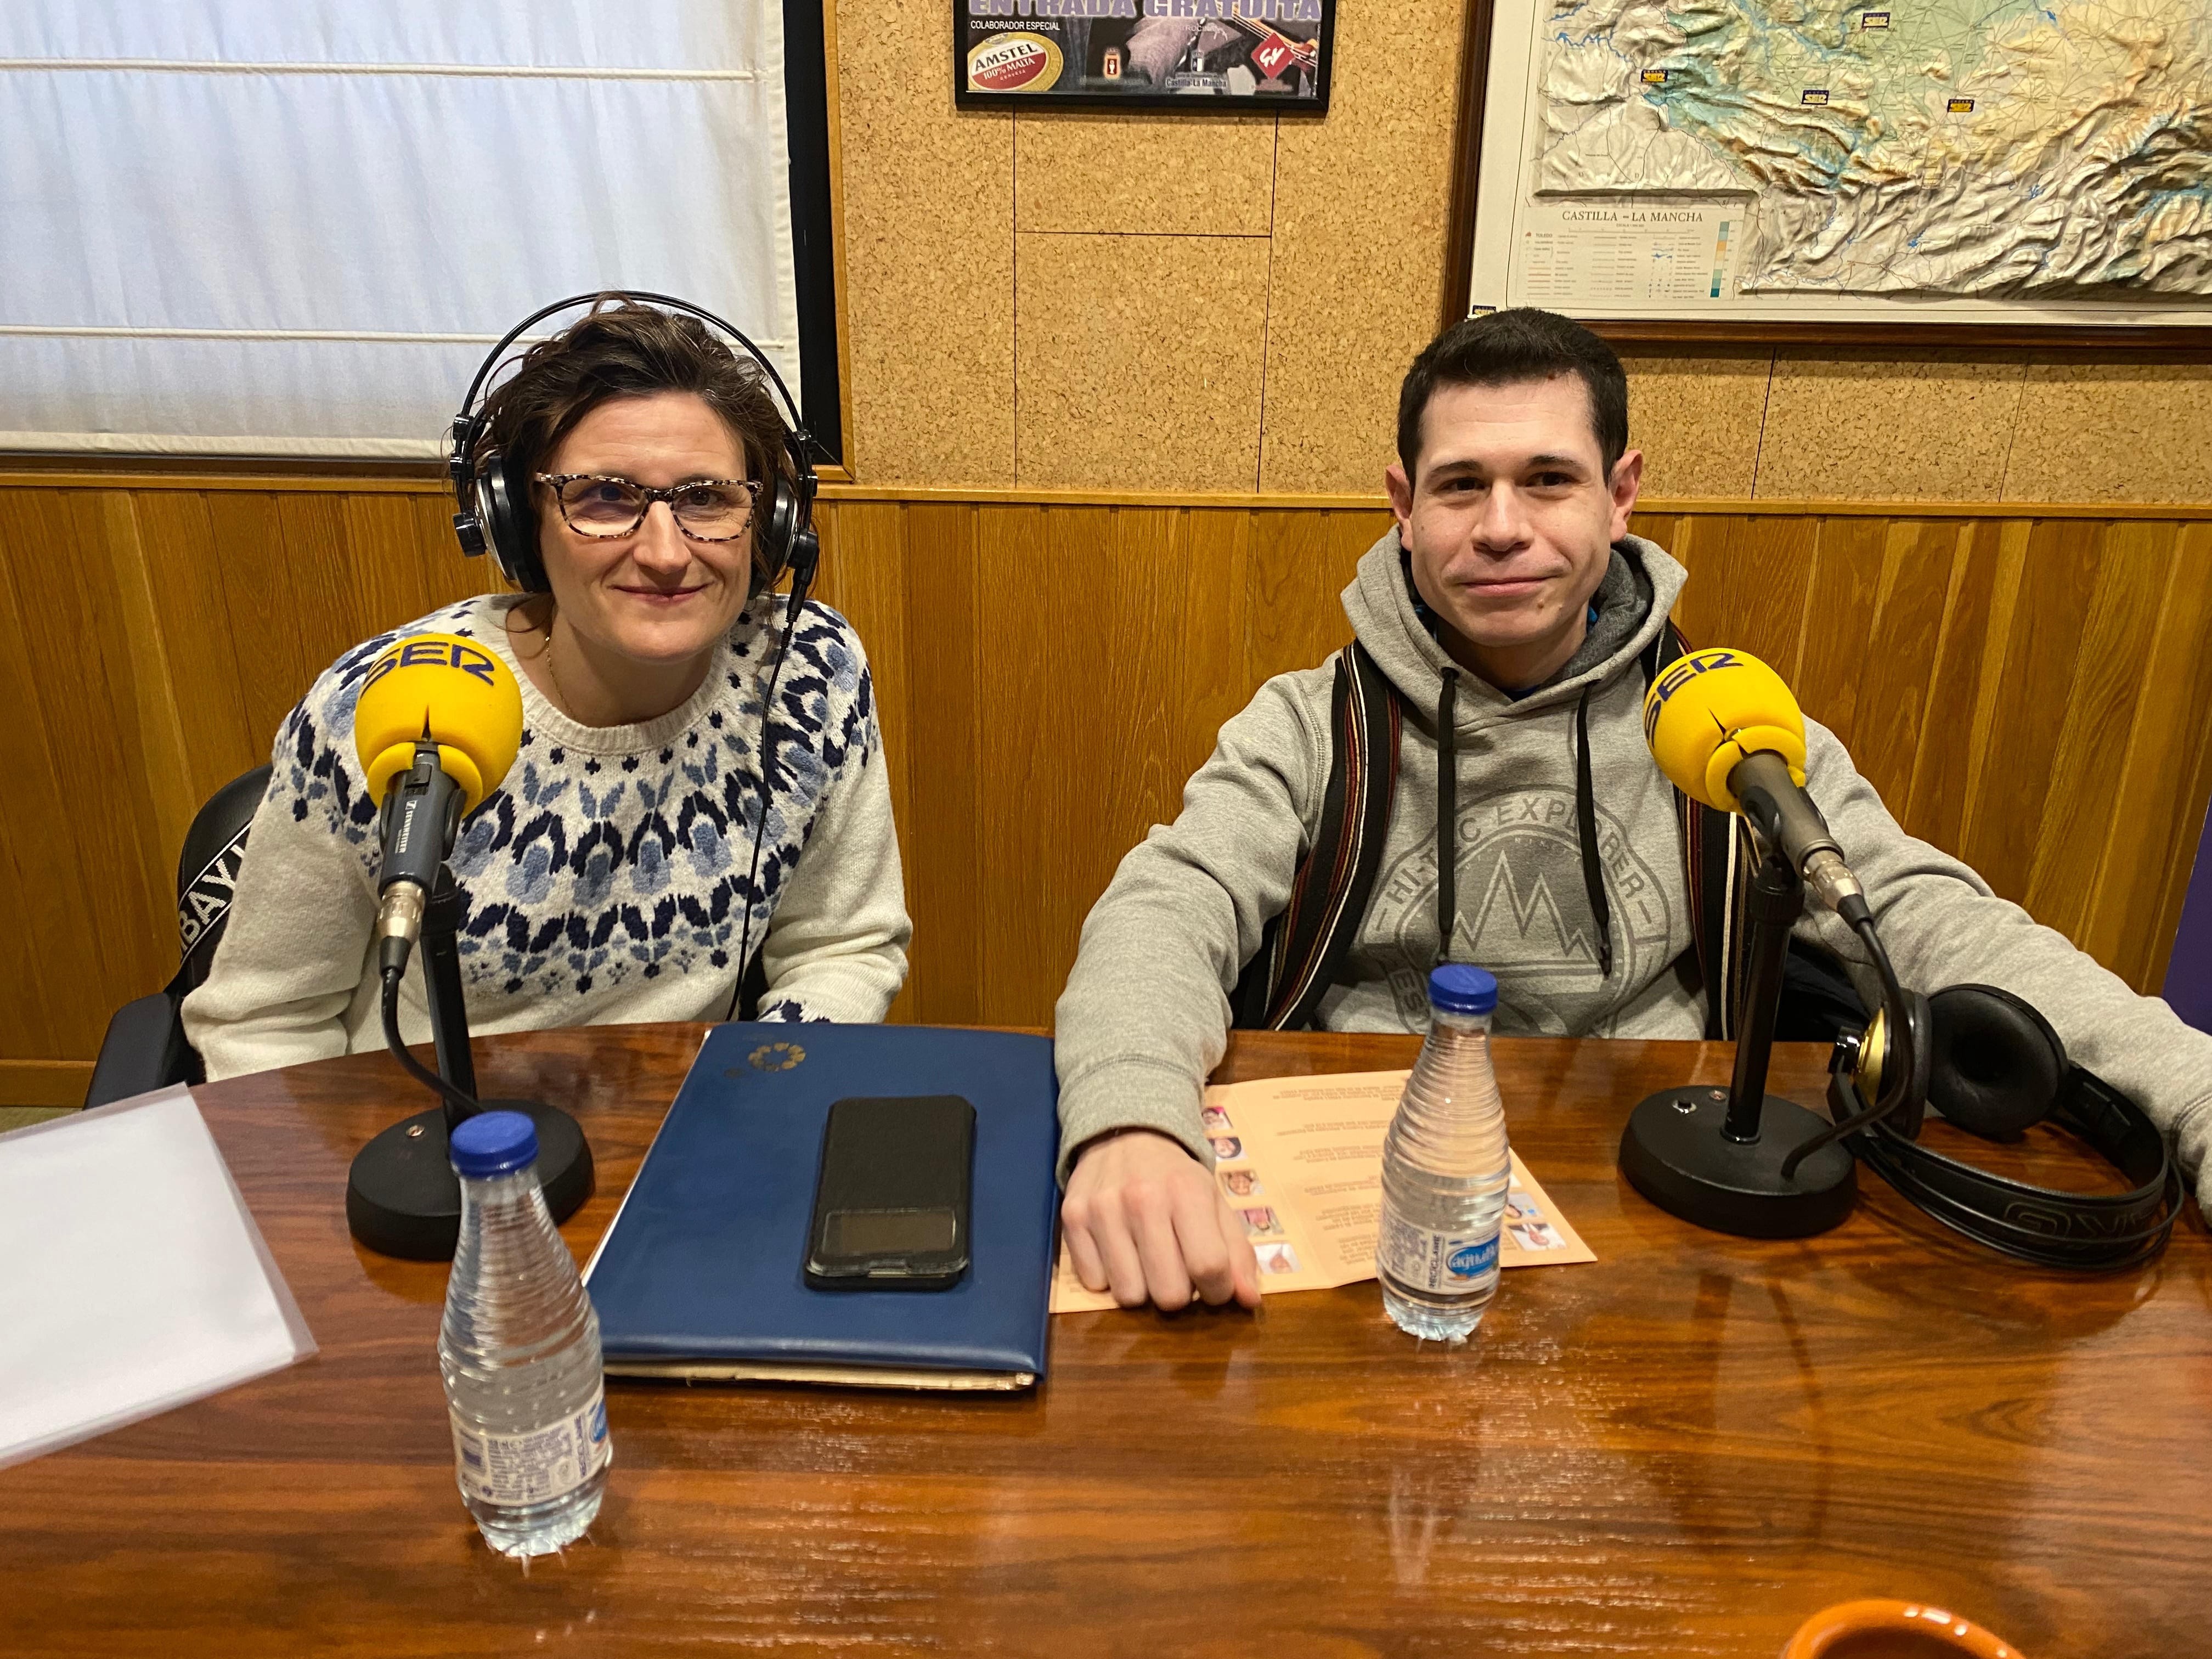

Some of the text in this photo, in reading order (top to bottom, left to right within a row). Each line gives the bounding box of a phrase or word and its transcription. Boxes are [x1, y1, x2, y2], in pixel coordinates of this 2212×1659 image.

[969, 0, 1321, 20] ENTRADA GRATUITA
[970, 20, 1060, 31] COLABORADOR ESPECIAL
[975, 43, 1038, 72] AMSTEL
[983, 57, 1036, 80] 100% MALTA
[1562, 211, 1618, 221] CASTILLA
[1650, 212, 1703, 222] MANCHA
[360, 641, 495, 701] SER
[1645, 653, 1744, 749] SER
[1386, 816, 1481, 905] HI-TC
